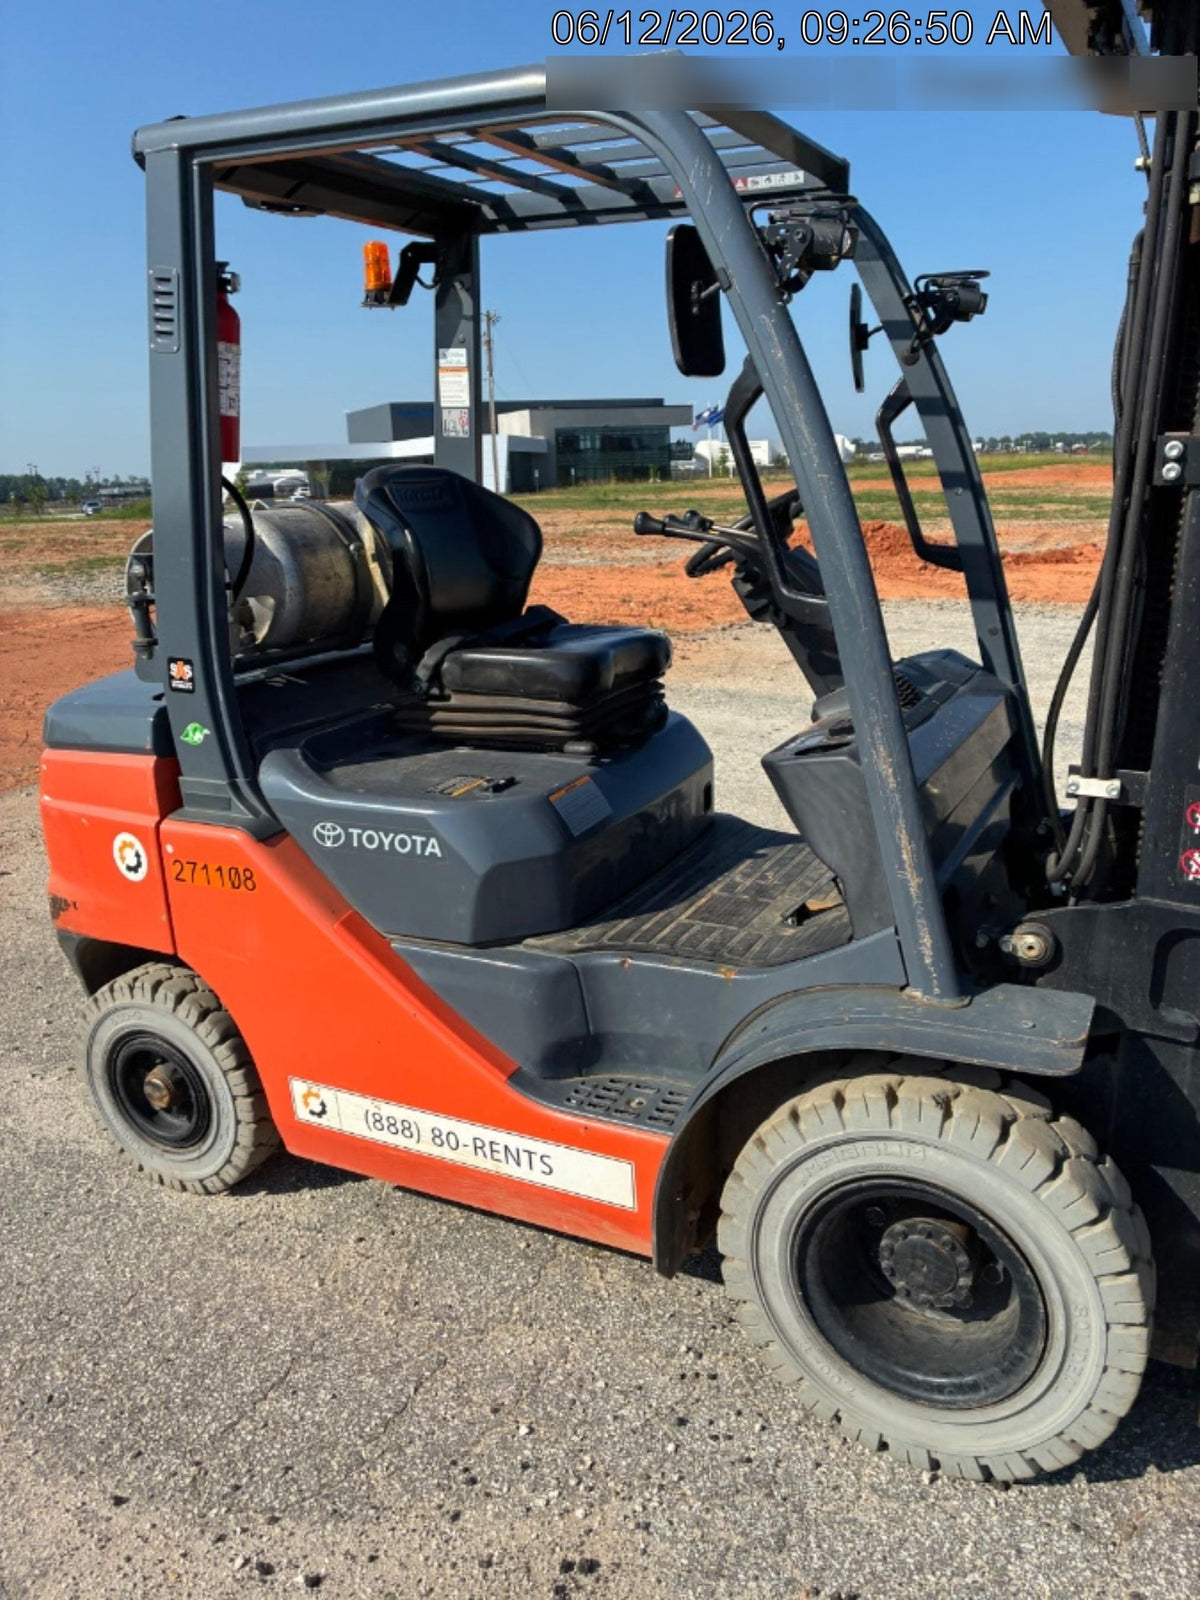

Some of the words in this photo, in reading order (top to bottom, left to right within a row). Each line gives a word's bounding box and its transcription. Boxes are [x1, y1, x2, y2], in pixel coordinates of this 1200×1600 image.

[348, 828, 443, 858] TOYOTA
[172, 859, 257, 892] 271108
[364, 1109, 421, 1144] (888)
[431, 1126, 554, 1176] 80-RENTS
